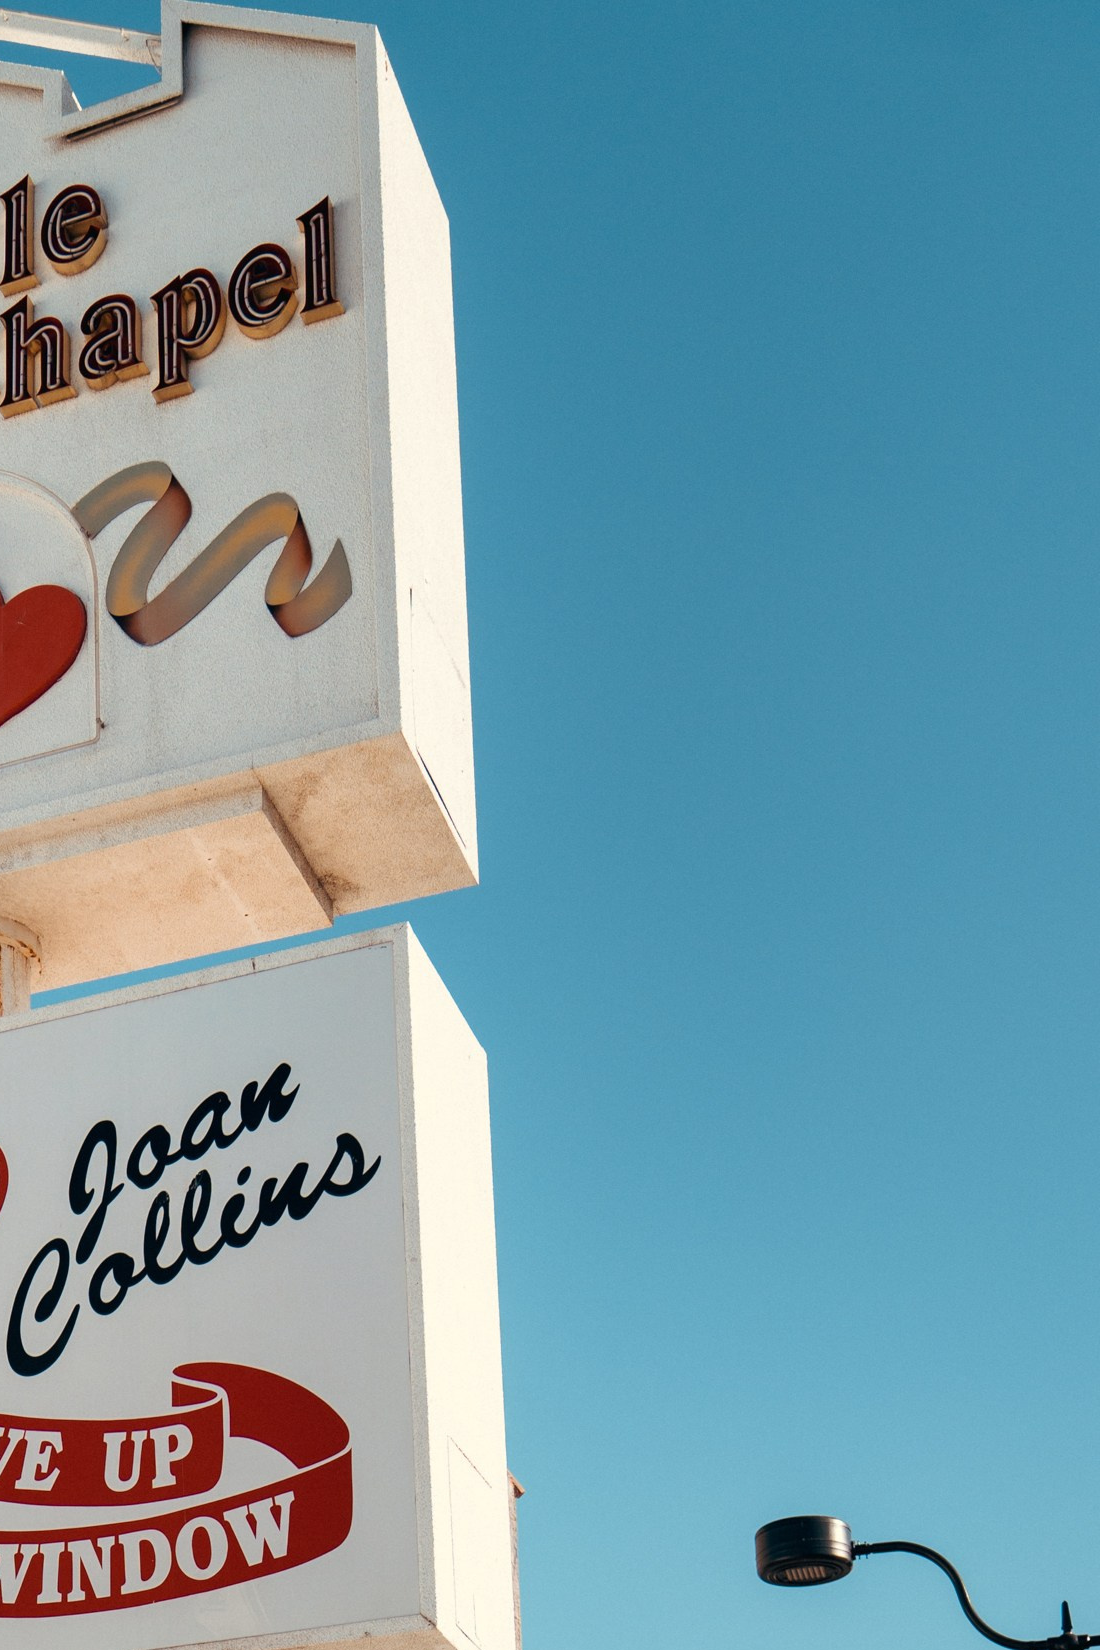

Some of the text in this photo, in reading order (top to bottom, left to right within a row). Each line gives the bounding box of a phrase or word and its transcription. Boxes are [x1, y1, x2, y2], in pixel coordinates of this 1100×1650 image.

[6, 1132, 381, 1378] Collins
[68, 1062, 301, 1263] Joan
[102, 1422, 195, 1490] UP
